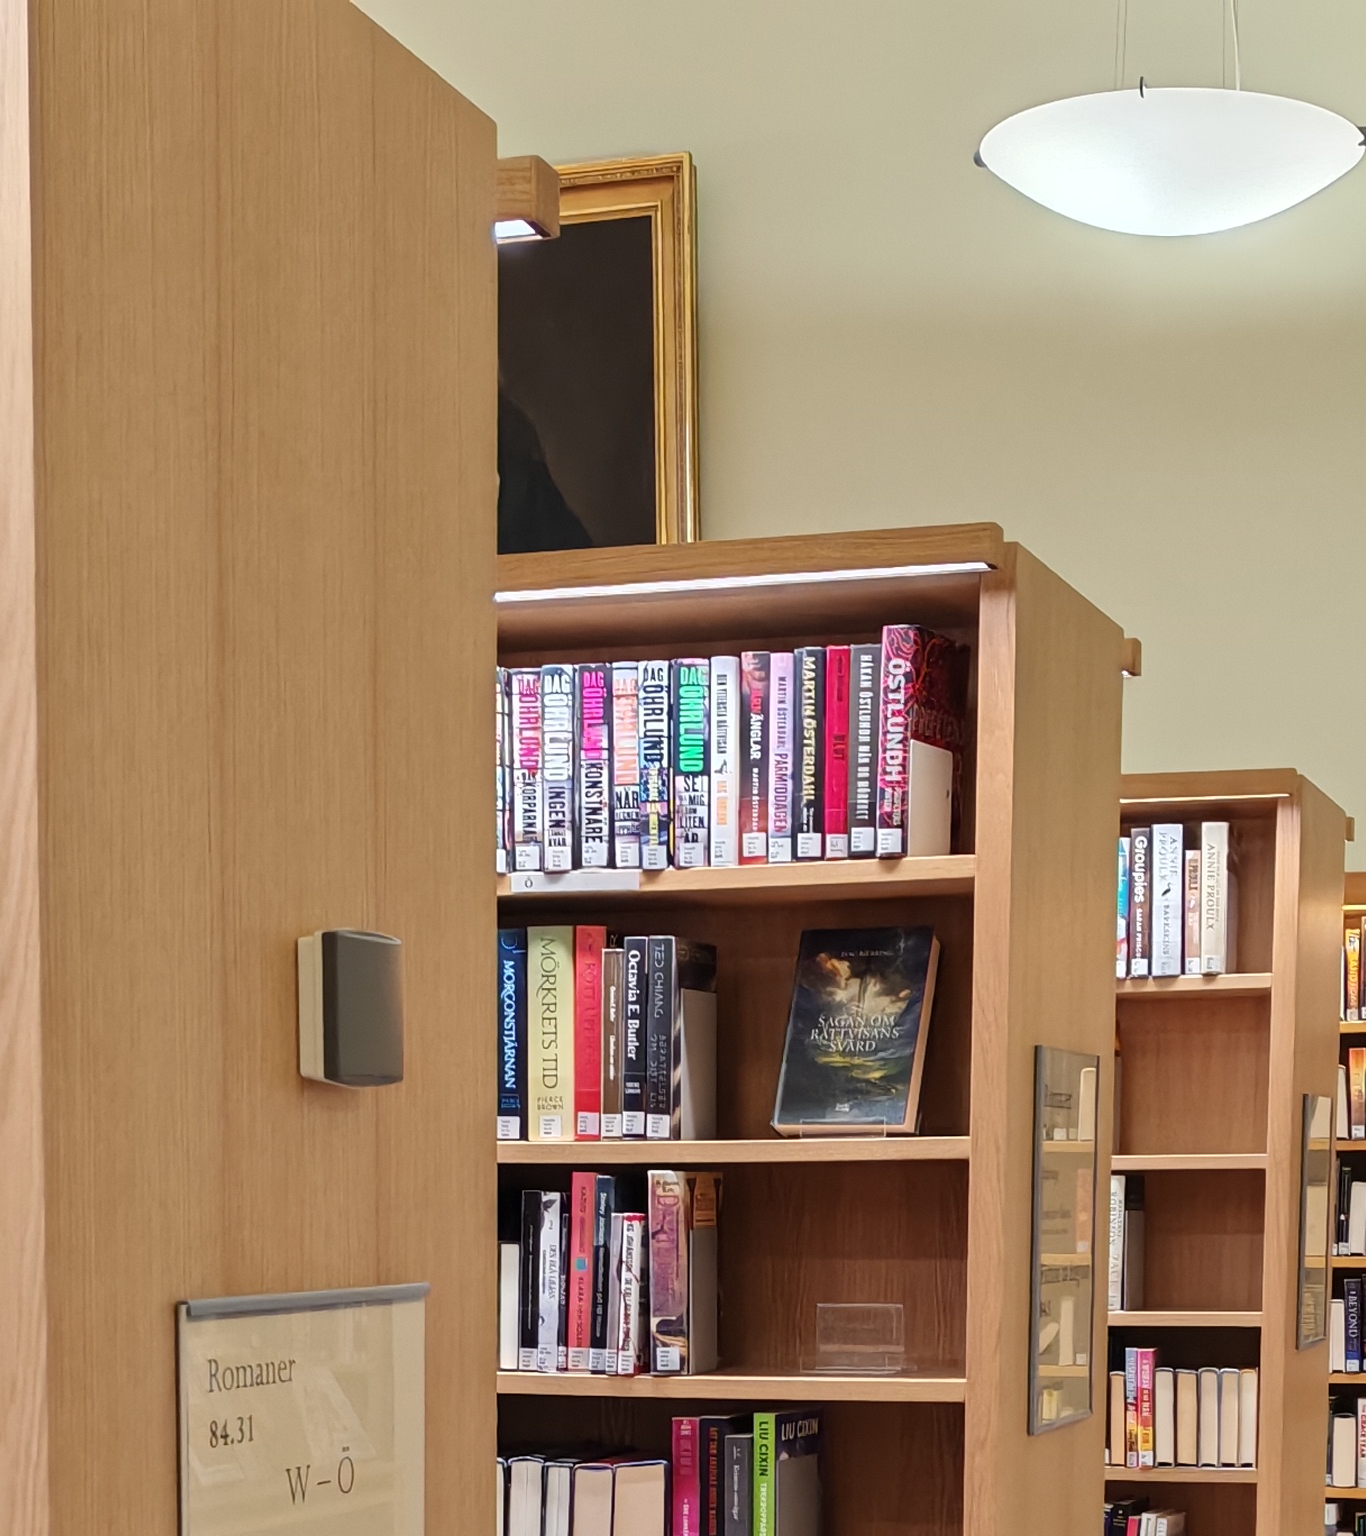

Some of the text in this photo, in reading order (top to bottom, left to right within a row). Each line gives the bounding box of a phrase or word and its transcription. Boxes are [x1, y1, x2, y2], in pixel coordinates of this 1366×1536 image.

[680, 667, 707, 685] DAG
[679, 686, 706, 772] ÖHRLUND
[884, 659, 911, 782] ÖSTLUNDH
[1132, 836, 1147, 903] Groupies
[1206, 843, 1215, 930] ANNIE PROULX
[628, 950, 640, 1000] Octavia
[503, 960, 517, 1088] MORGONSTJÄRNAN
[537, 938, 560, 1088] MÖRKRETS TID
[811, 1027, 899, 1041] RÄTTVISANS
[818, 1015, 897, 1028] SAGAN OM
[628, 1020, 640, 1060] Butler
[829, 1039, 875, 1052] SVÄRD
[1348, 1296, 1359, 1338] BEYOND
[207, 1356, 296, 1393] Romaner
[209, 1415, 254, 1448] 84.31
[759, 1420, 769, 1477] LIU CIXIN
[285, 1465, 311, 1504] W
[338, 1445, 355, 1493] Ö
